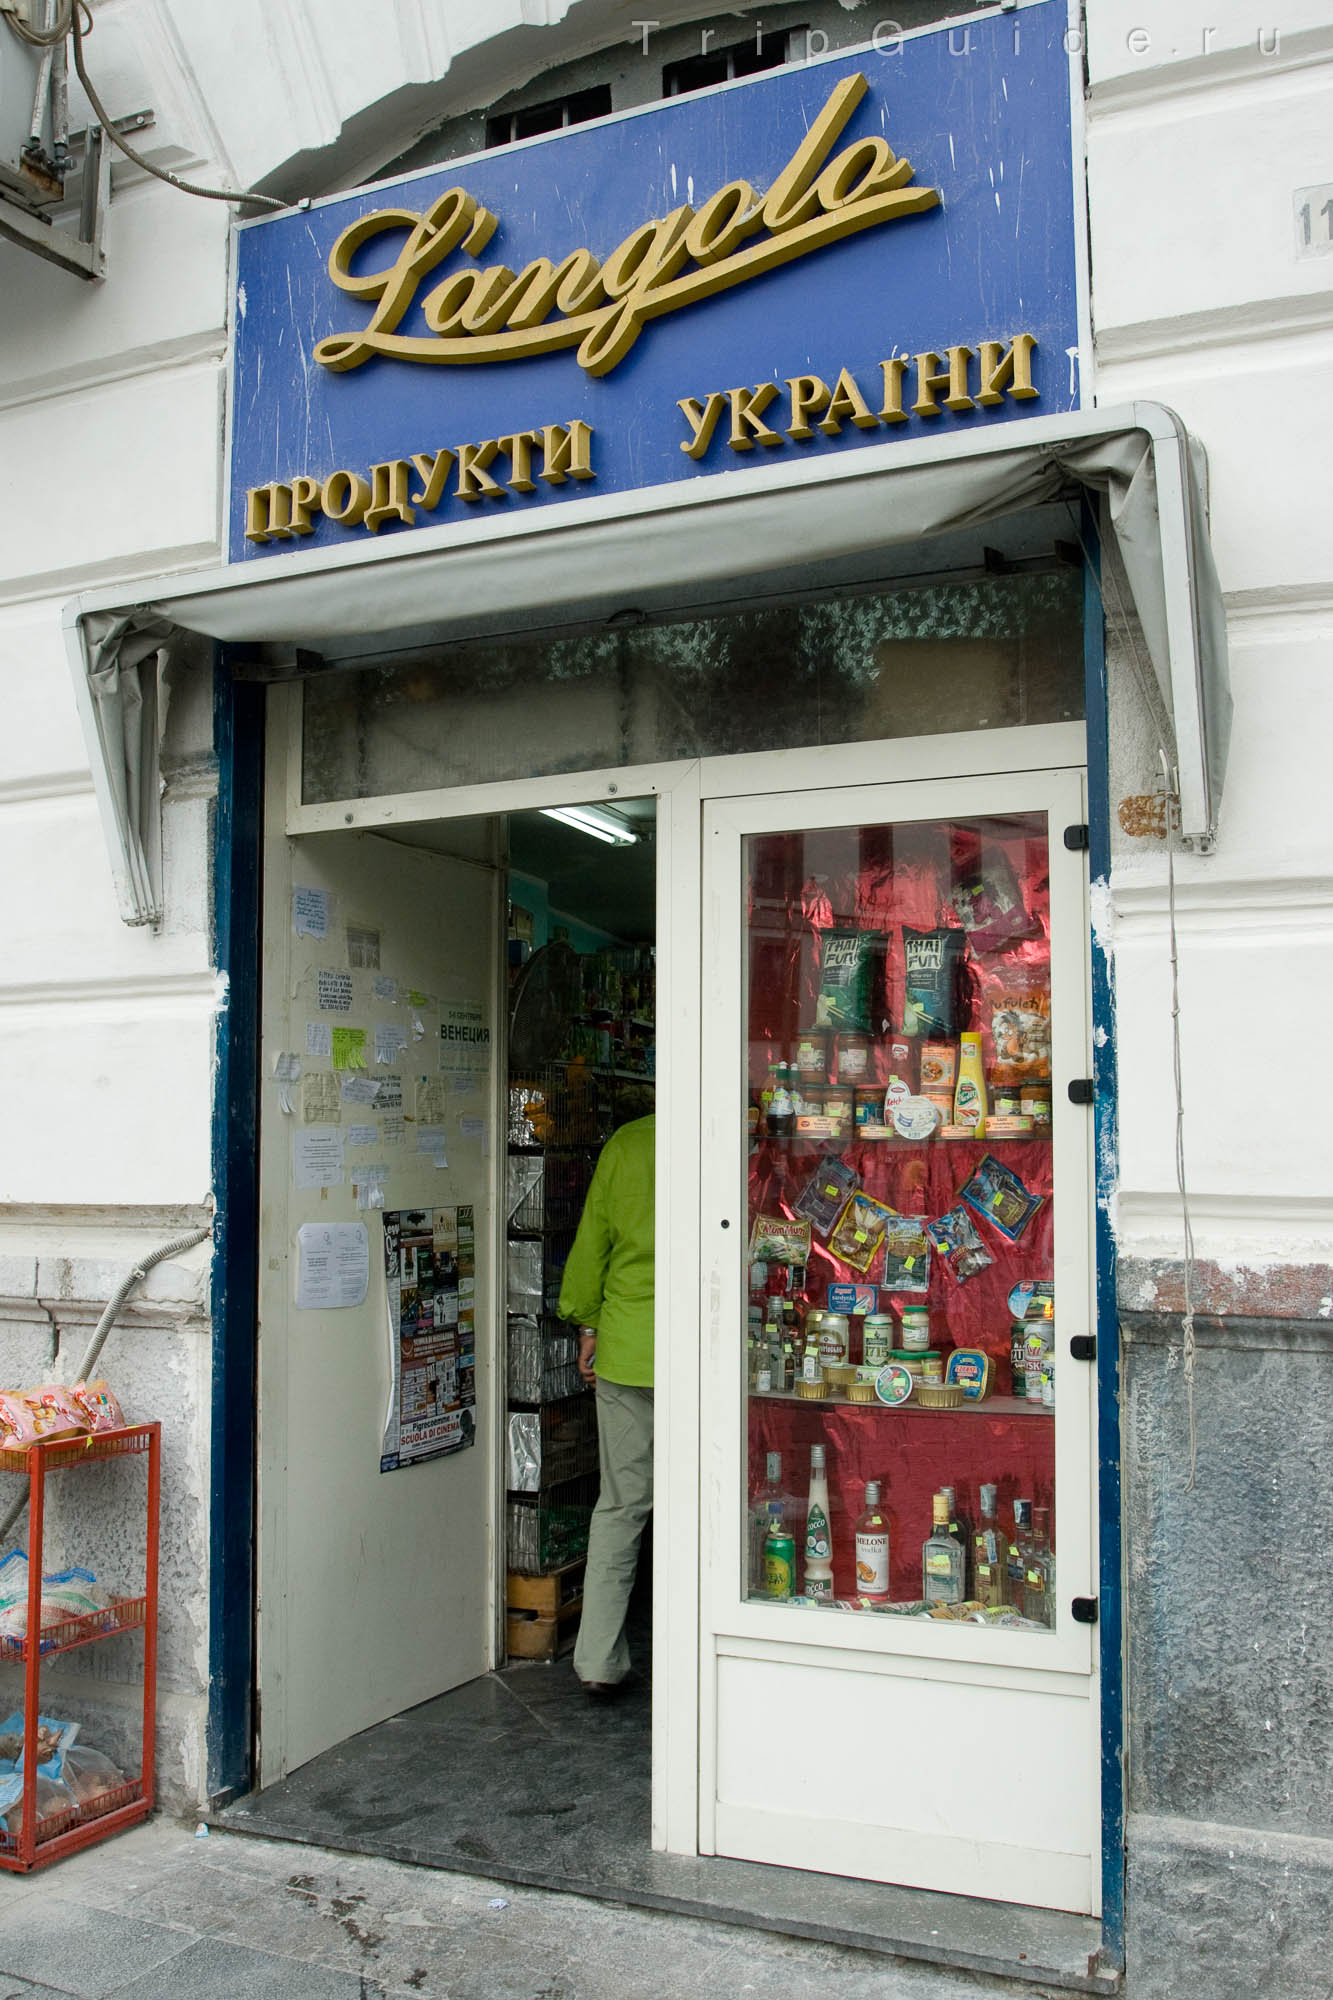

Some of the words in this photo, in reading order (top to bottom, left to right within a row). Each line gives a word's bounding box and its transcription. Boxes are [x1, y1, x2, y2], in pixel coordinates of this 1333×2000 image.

[245, 420, 597, 542] ПРОДУКТИ
[825, 939, 857, 952] THAI
[907, 941, 940, 953] THAI
[440, 1024, 490, 1044] ВЕНЕЦИЯ
[400, 1430, 427, 1445] SCUOLA
[429, 1429, 436, 1438] DI
[436, 1421, 460, 1436] CINEMA
[856, 1537, 888, 1546] MELONE
